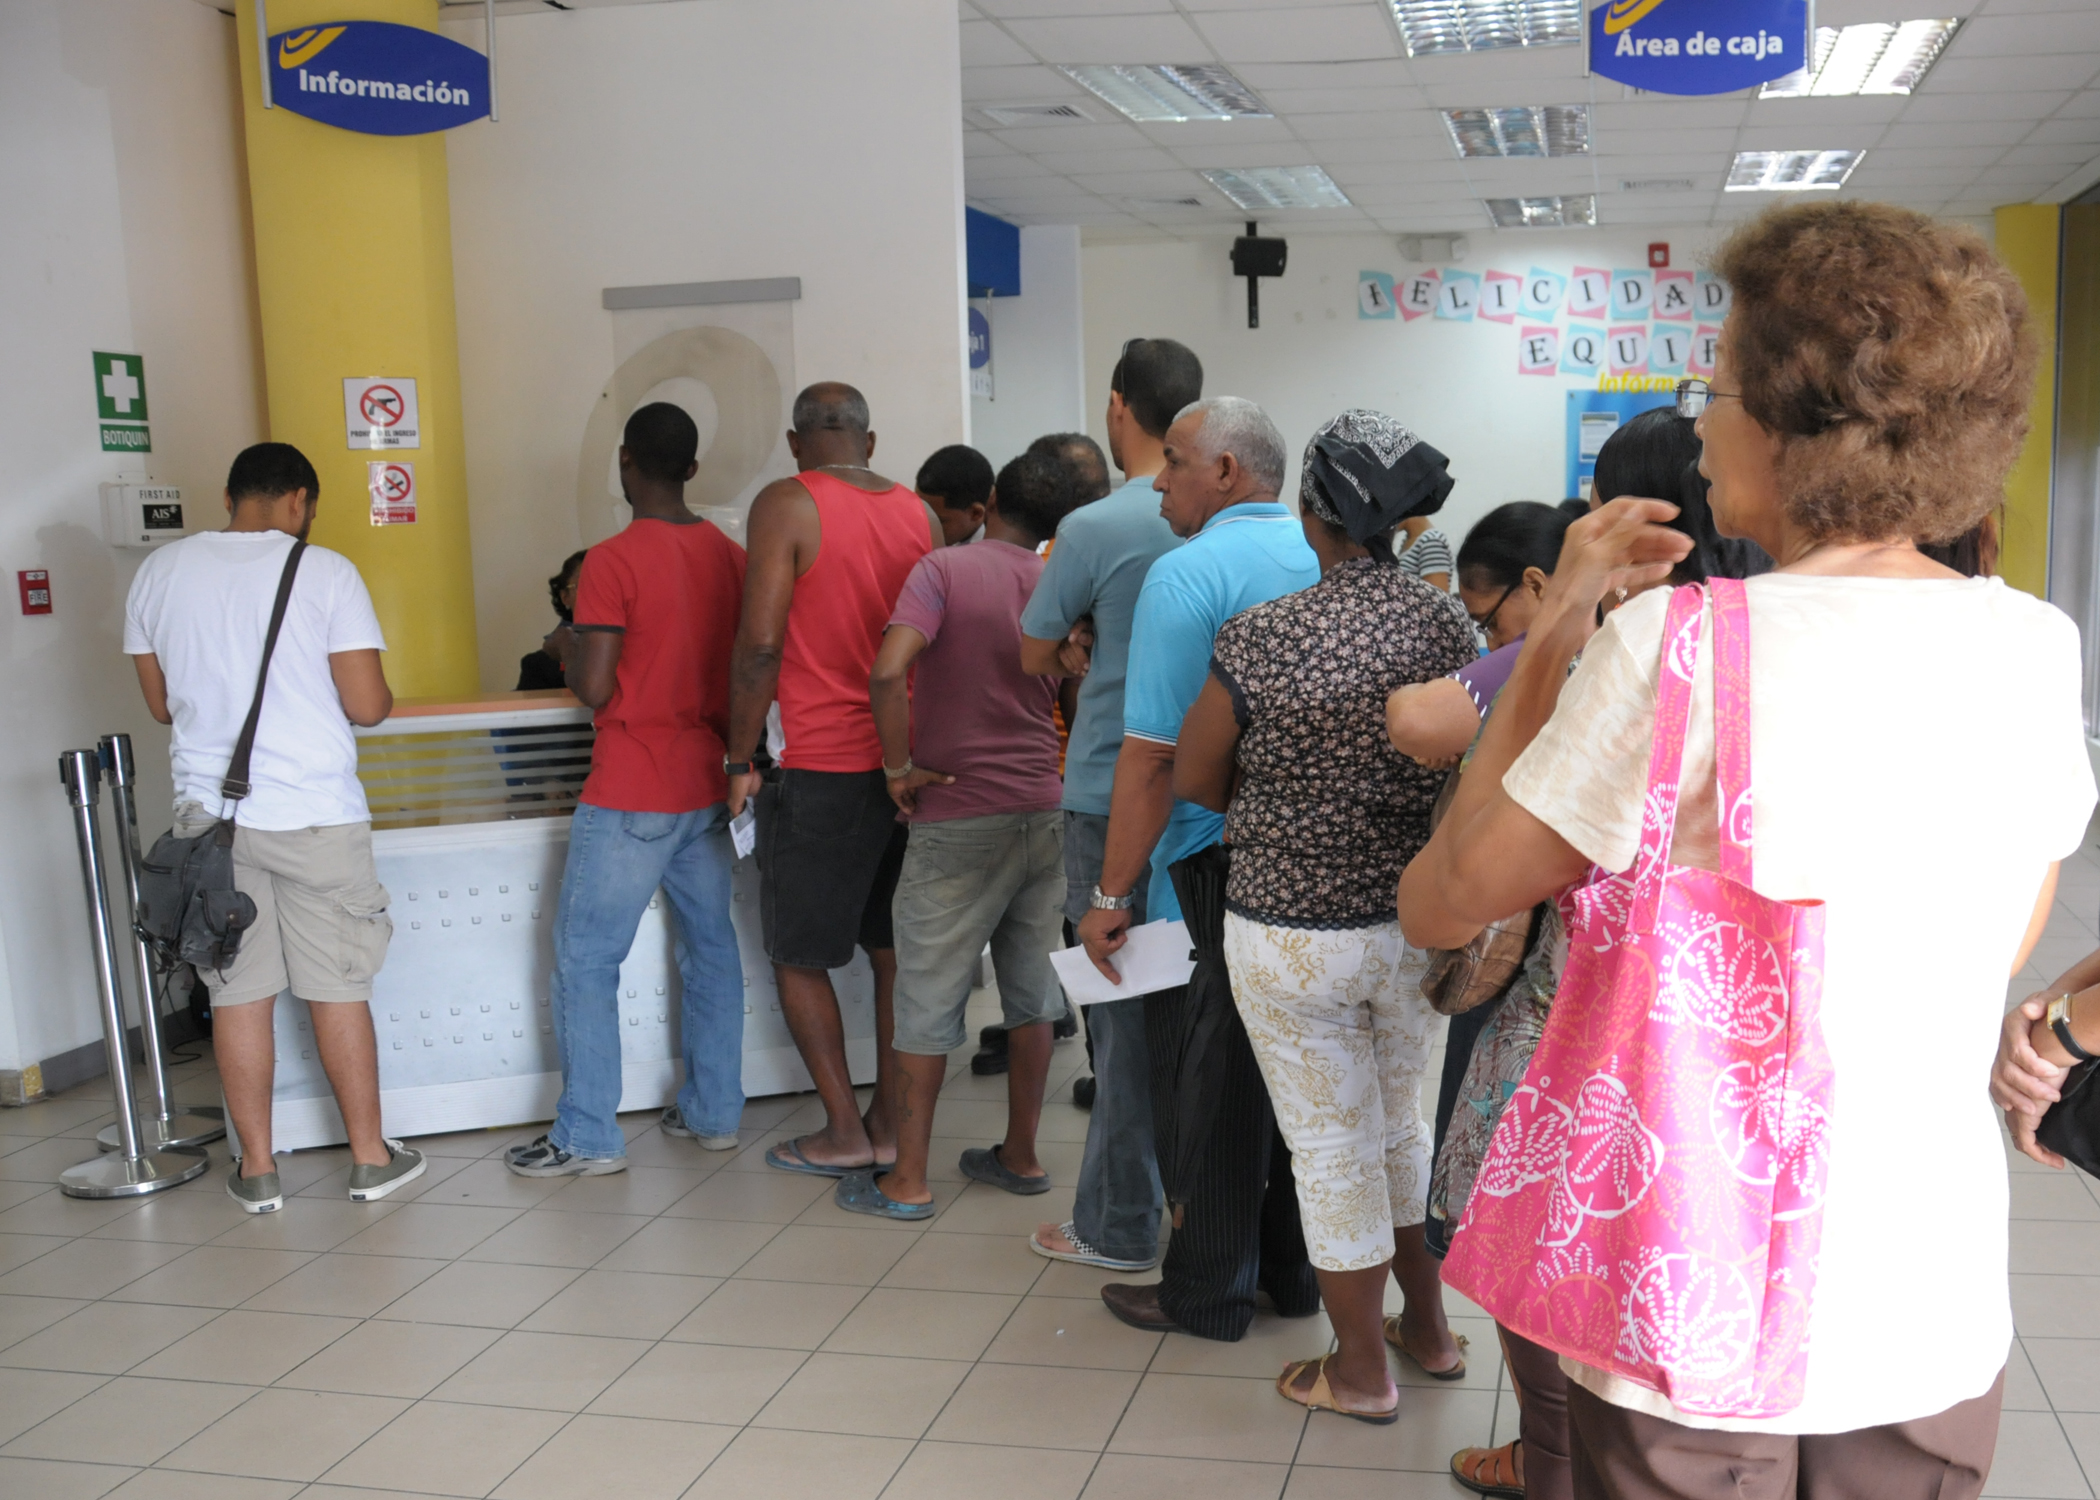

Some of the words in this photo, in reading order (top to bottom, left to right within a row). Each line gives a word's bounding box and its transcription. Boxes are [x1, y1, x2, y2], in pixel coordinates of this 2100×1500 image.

[1615, 29, 1680, 57] Área
[1686, 31, 1721, 56] de
[1727, 29, 1784, 61] caja
[299, 69, 470, 106] Información
[1597, 369, 1714, 394] Infórm
[103, 429, 150, 448] BOTIQUIN
[139, 489, 163, 499] FIRST
[165, 489, 181, 499] AID
[152, 508, 170, 519] AIS
